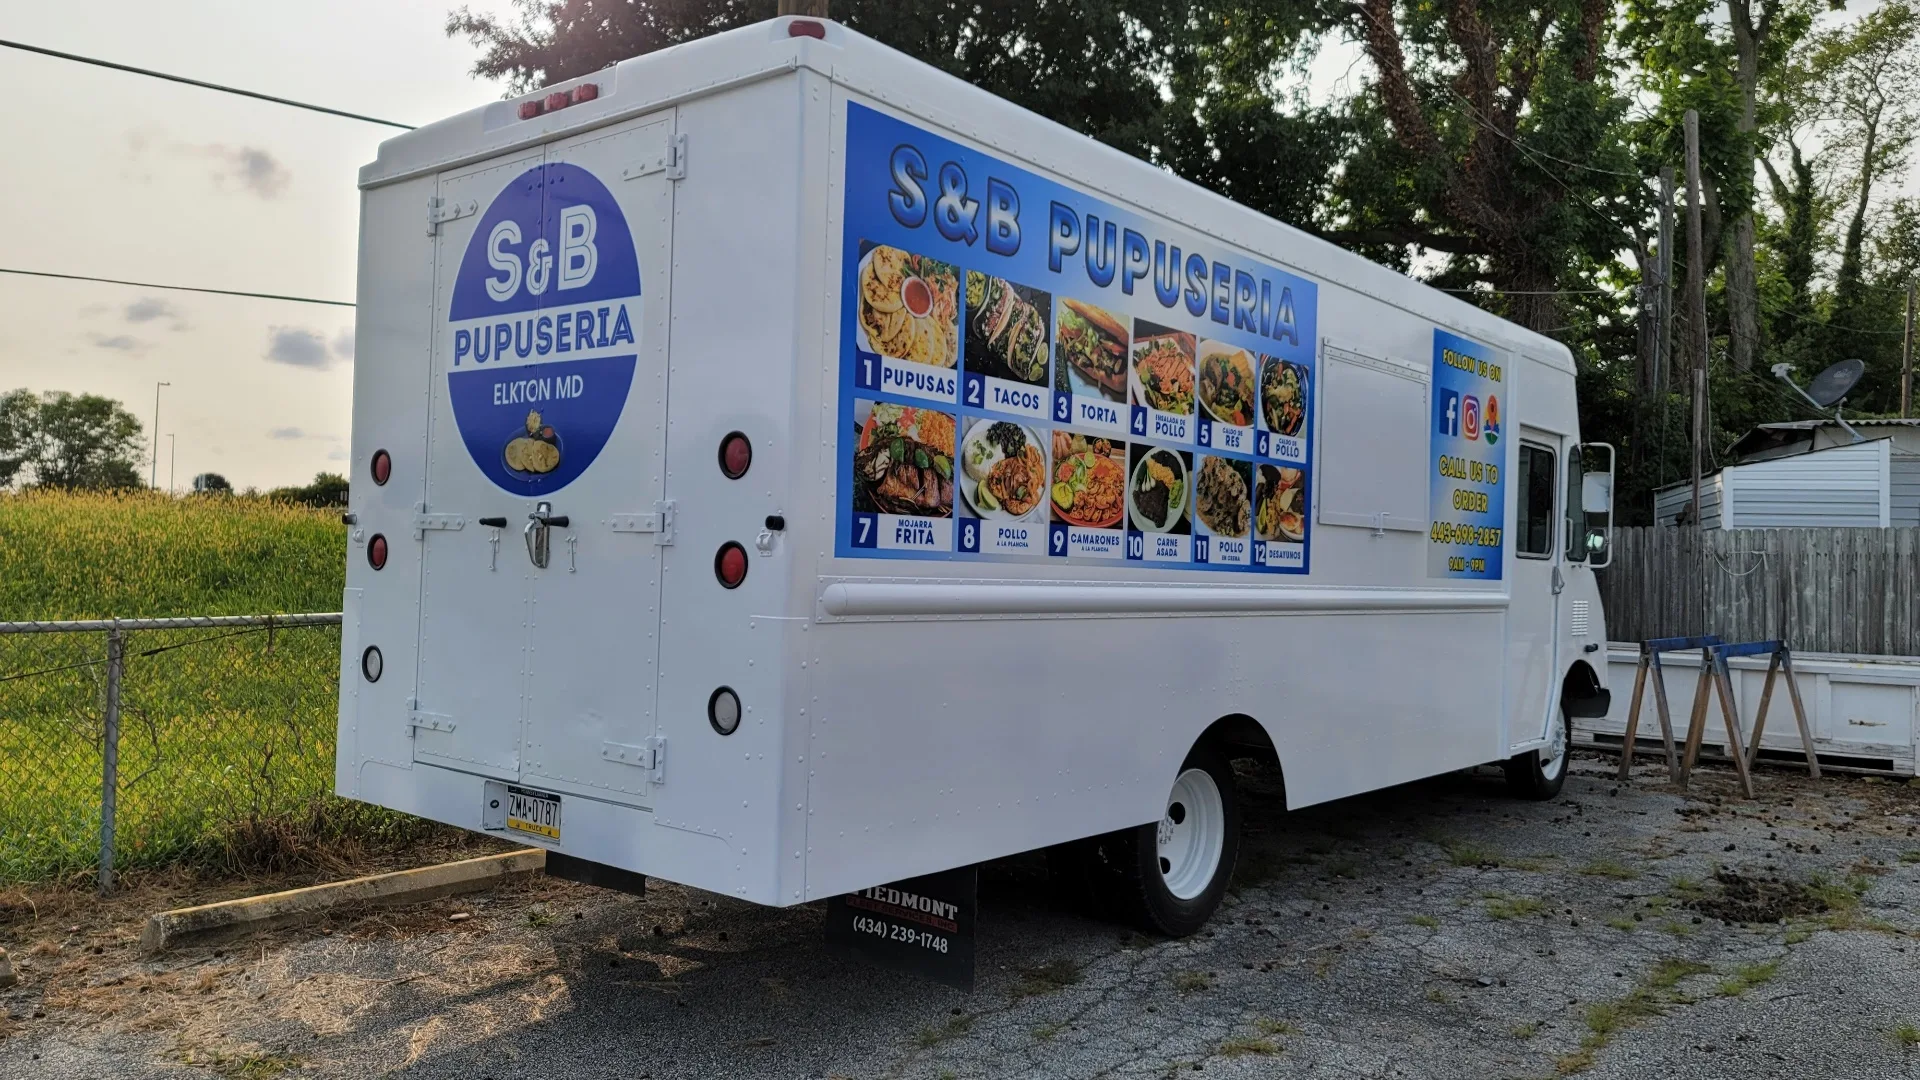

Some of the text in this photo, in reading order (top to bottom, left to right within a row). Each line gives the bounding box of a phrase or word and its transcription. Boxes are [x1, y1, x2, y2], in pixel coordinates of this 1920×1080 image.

[485, 204, 598, 302] S&B
[887, 143, 1299, 347] S&B PUPUSERIA
[454, 304, 635, 366] PUPUSERIA
[863, 360, 873, 386] 1
[1443, 349, 1501, 382] FOLLOW US ON
[493, 374, 584, 406] ELKTON MD
[883, 366, 955, 396] PUPUSAS
[968, 379, 980, 404] 2
[994, 387, 1039, 410] TACOS
[1057, 397, 1068, 419] 3
[1081, 403, 1118, 425] TORTA
[1133, 411, 1144, 433] 4
[1155, 414, 1186, 426] ENSALADA DE
[1155, 421, 1186, 438] POLLO
[1200, 424, 1209, 444] 5
[1222, 427, 1243, 437] CALDO DE
[1278, 437, 1298, 447] CALDO DE
[1225, 436, 1240, 449] RES
[1259, 435, 1267, 454] 6
[1275, 442, 1300, 458] POLLO
[1439, 455, 1498, 484] CALL US TO
[1453, 489, 1488, 513] ORDER
[858, 517, 872, 544] 7
[898, 519, 933, 529] MOJARRA
[998, 528, 1028, 540] POLLO
[1430, 521, 1502, 547] 443-698-2857
[896, 528, 934, 545] FRITA
[963, 524, 975, 549] 8
[1053, 530, 1064, 553] 9
[1070, 533, 1120, 546] CAMARONES
[1128, 536, 1143, 557] 10
[1156, 538, 1178, 547] CARNE
[1156, 547, 1178, 557] ASADA
[1196, 540, 1207, 560] 11
[1219, 542, 1244, 553] POLLO
[1254, 544, 1266, 562] 12
[1269, 550, 1301, 560] DESAYUNOS
[1449, 556, 1465, 572] 9AM
[1470, 558, 1485, 573] 9PM
[524, 822, 543, 833] TRUCK
[853, 915, 948, 954] (434) 239-1748
